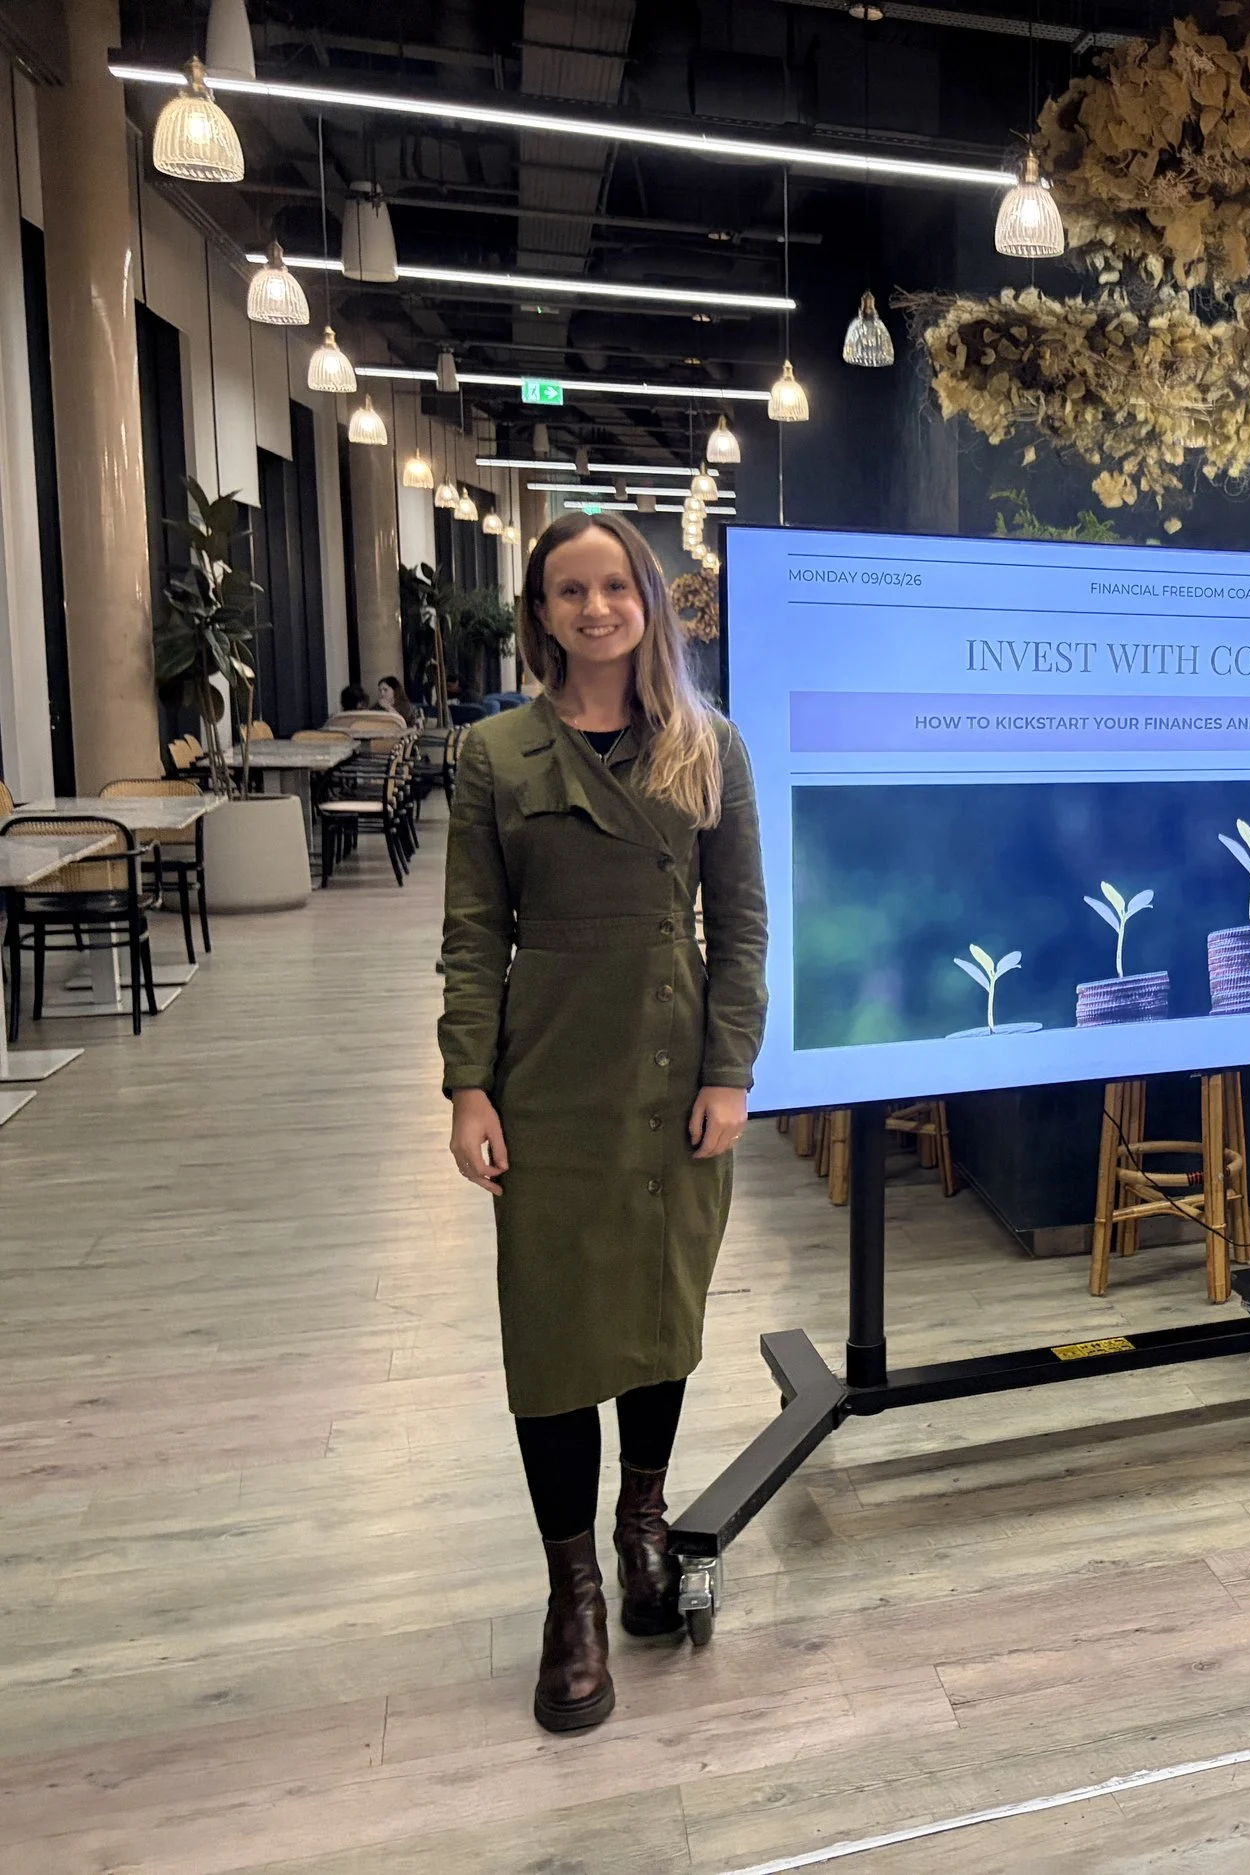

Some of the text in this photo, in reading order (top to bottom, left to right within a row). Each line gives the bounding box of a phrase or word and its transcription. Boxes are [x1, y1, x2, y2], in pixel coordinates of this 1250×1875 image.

[788, 569, 922, 587] MONDAY 09/03/26
[1090, 582, 1159, 597] FINANCIAL
[1162, 585, 1225, 599] FREEDOM
[965, 639, 1097, 673] INVEST
[1106, 643, 1200, 675] WITH
[914, 716, 962, 730] HOW
[966, 716, 990, 730] TO
[996, 717, 1089, 730] KICKSTART
[1093, 717, 1139, 730] YOUR
[1144, 717, 1223, 730] FINANCES
